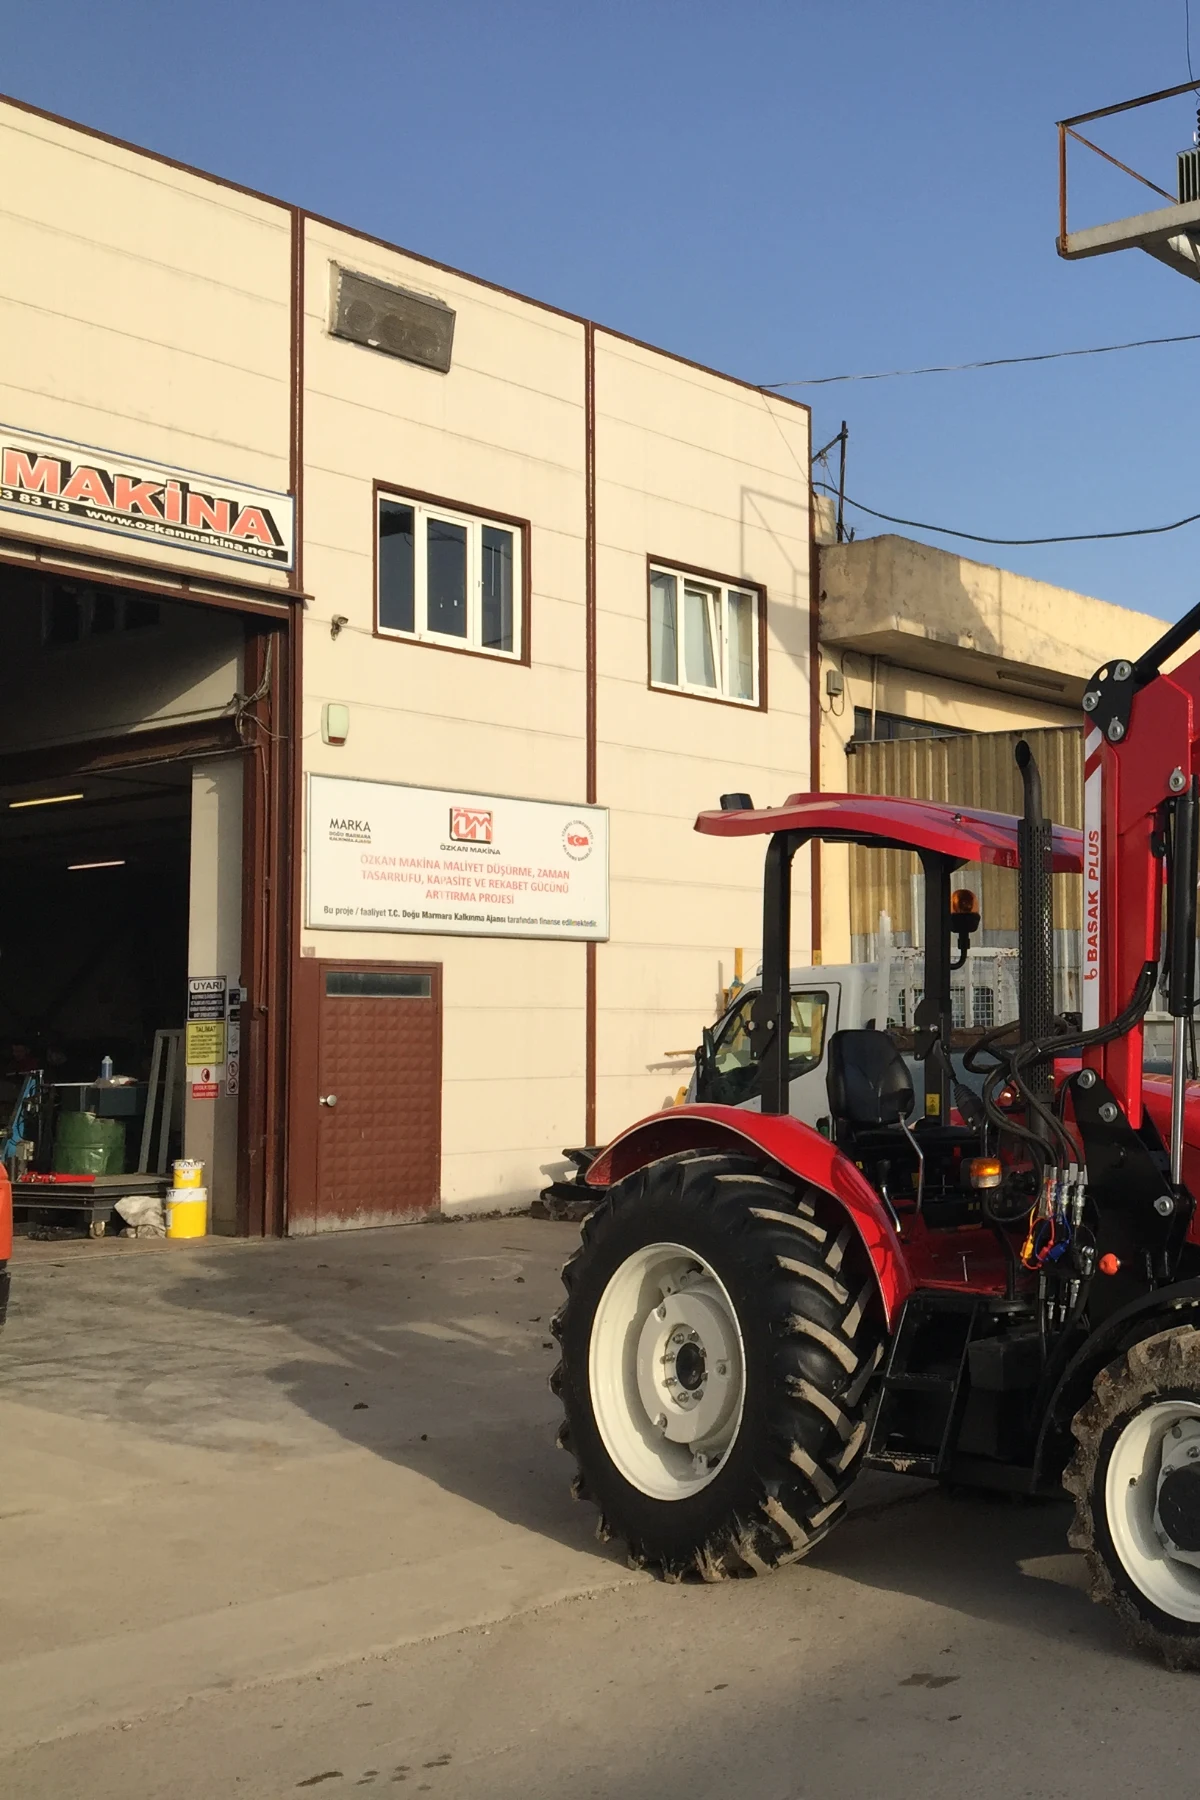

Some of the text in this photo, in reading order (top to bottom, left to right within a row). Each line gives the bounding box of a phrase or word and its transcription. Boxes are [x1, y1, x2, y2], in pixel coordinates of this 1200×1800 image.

[19, 493, 42, 506] 83
[48, 500, 70, 512] 13
[85, 509, 274, 559] www.ozkanmakina.net
[329, 818, 371, 832] MARKA
[440, 843, 501, 855] ÖZKAN MAKİNA
[1088, 830, 1099, 881] PLUS
[399, 857, 440, 870] MAKİNA
[444, 860, 483, 873] MALİYET
[487, 862, 535, 878] DÜŞÜRME,
[537, 869, 570, 879] ZAMAN
[361, 870, 569, 894] TASARRUFU, KAPASİTE VE REKABET GÜCÜNÜ
[425, 889, 514, 905] ARTTIRMA PROJESİ
[324, 906, 333, 914] Bu
[335, 906, 354, 916] proje
[360, 908, 386, 918] faaliyet
[388, 909, 400, 917] T.C.
[402, 910, 420, 920] Doğu
[422, 911, 453, 920] Marmara
[454, 913, 485, 922] Kalkınma
[486, 915, 506, 924] Ajansı
[507, 916, 538, 925] tarafından
[539, 917, 561, 926] finanse
[193, 982, 222, 990] UYARI
